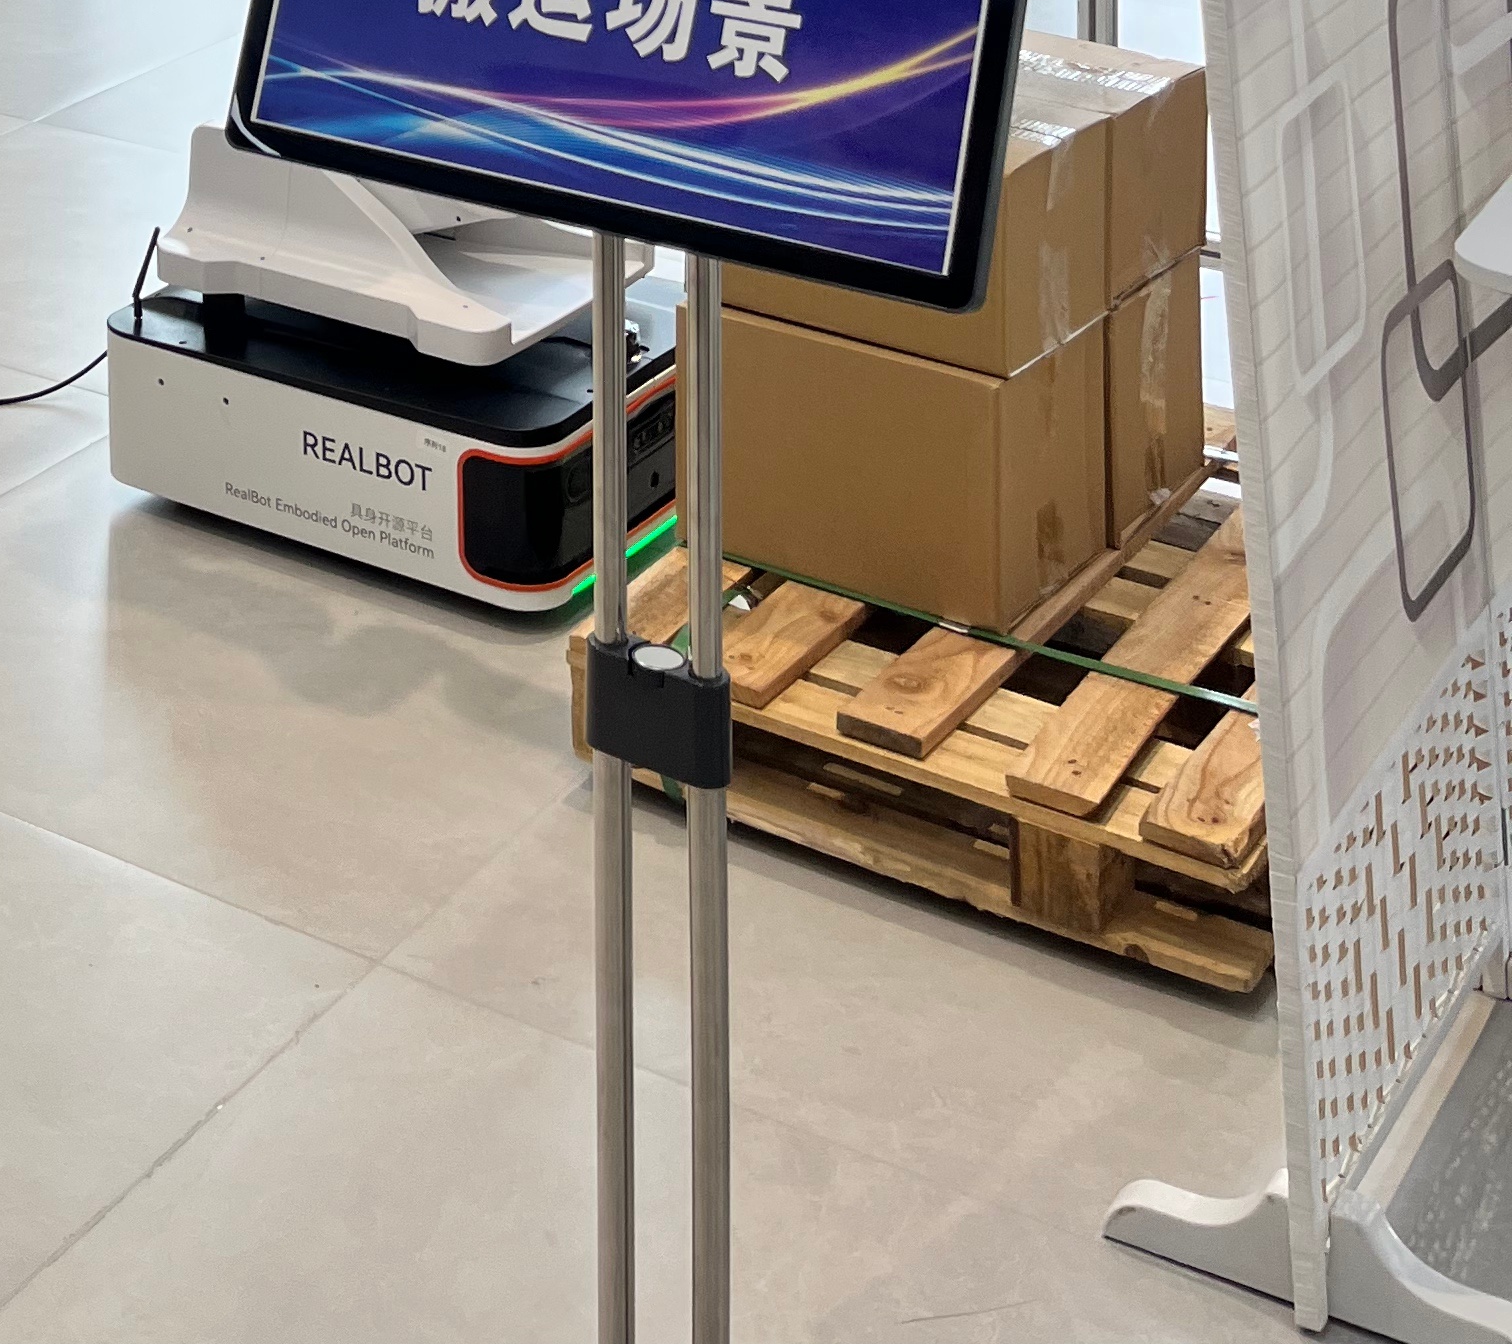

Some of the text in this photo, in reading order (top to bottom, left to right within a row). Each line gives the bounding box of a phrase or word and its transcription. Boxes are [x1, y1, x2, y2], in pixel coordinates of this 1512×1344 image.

[302, 430, 433, 491] REALBOT
[225, 481, 435, 560] RealBot Embodied Open Platform
[350, 502, 433, 542] 具身开源平台
